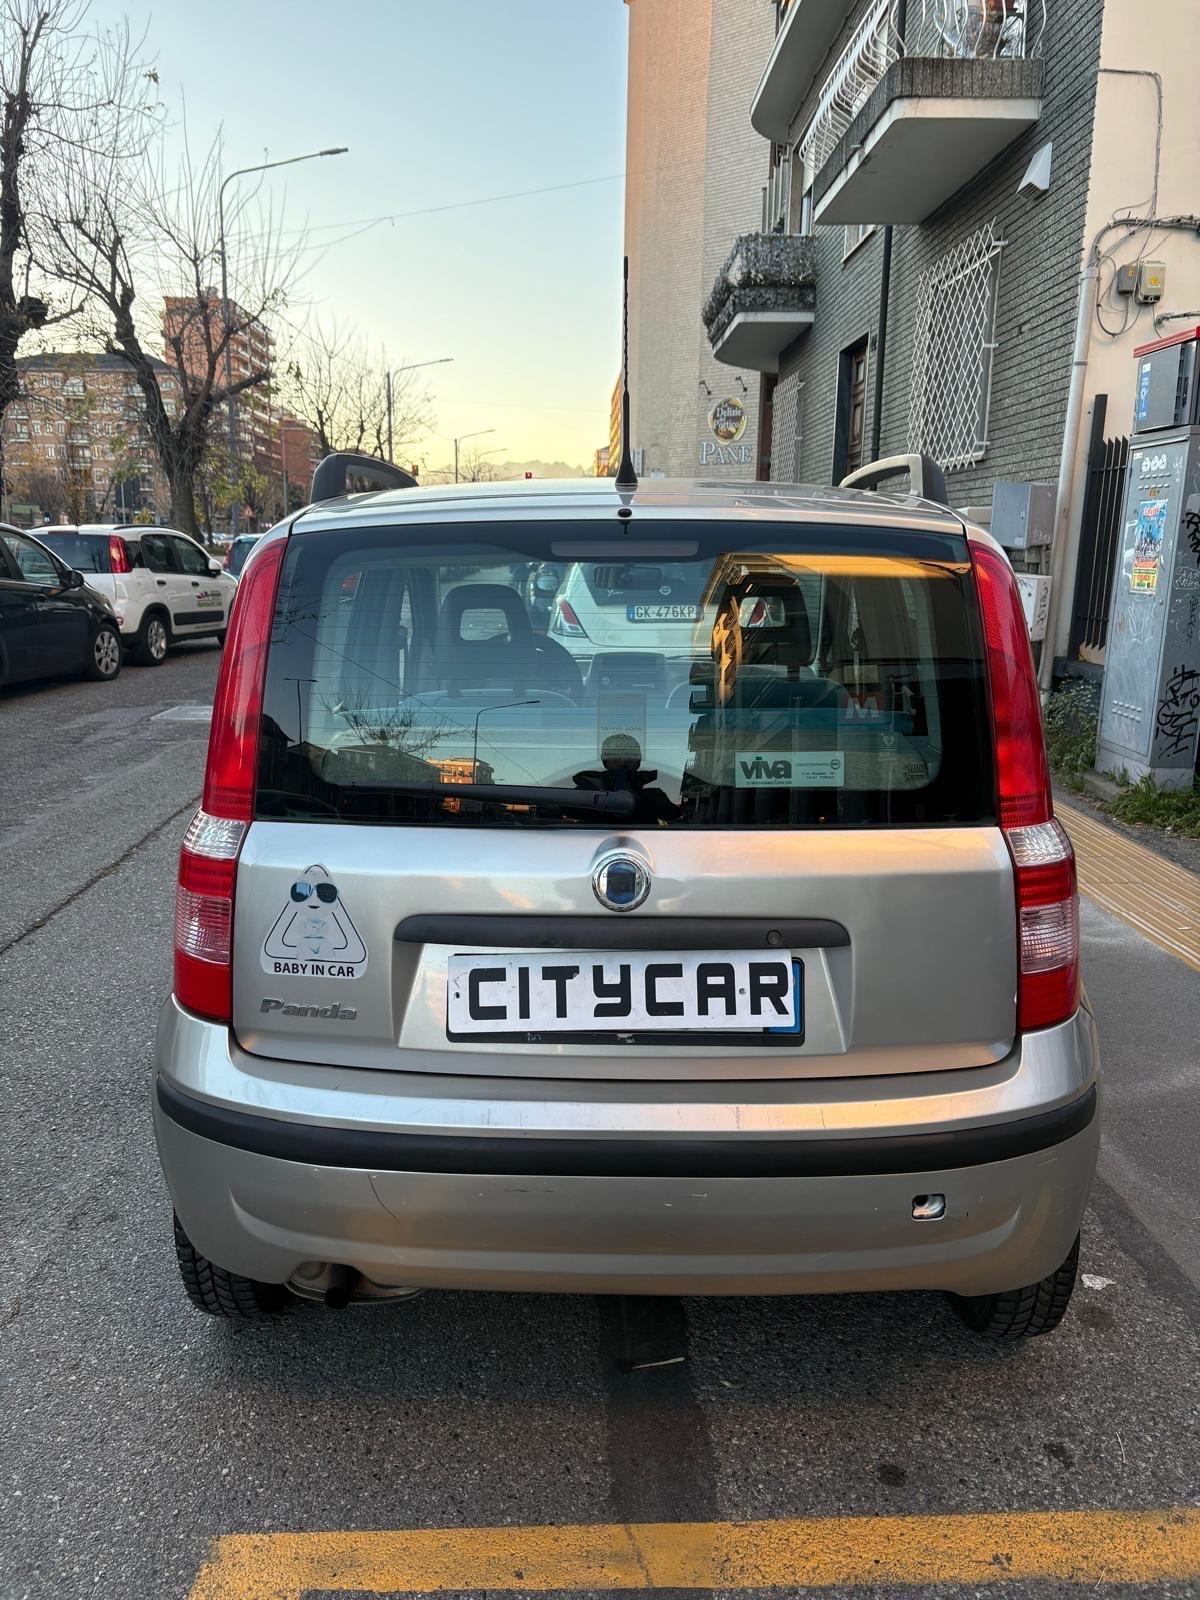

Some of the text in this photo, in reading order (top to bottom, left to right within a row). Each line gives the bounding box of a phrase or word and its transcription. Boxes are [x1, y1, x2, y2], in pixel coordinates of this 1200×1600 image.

[717, 407, 741, 417] Delizie
[713, 419, 740, 430] Portico
[700, 441, 753, 465] PANE
[636, 606, 651, 618] GK
[739, 756, 793, 779] viva
[273, 962, 355, 978] BABY IN CAR
[468, 961, 790, 1021] CITYCAR
[259, 997, 357, 1021] Panda
